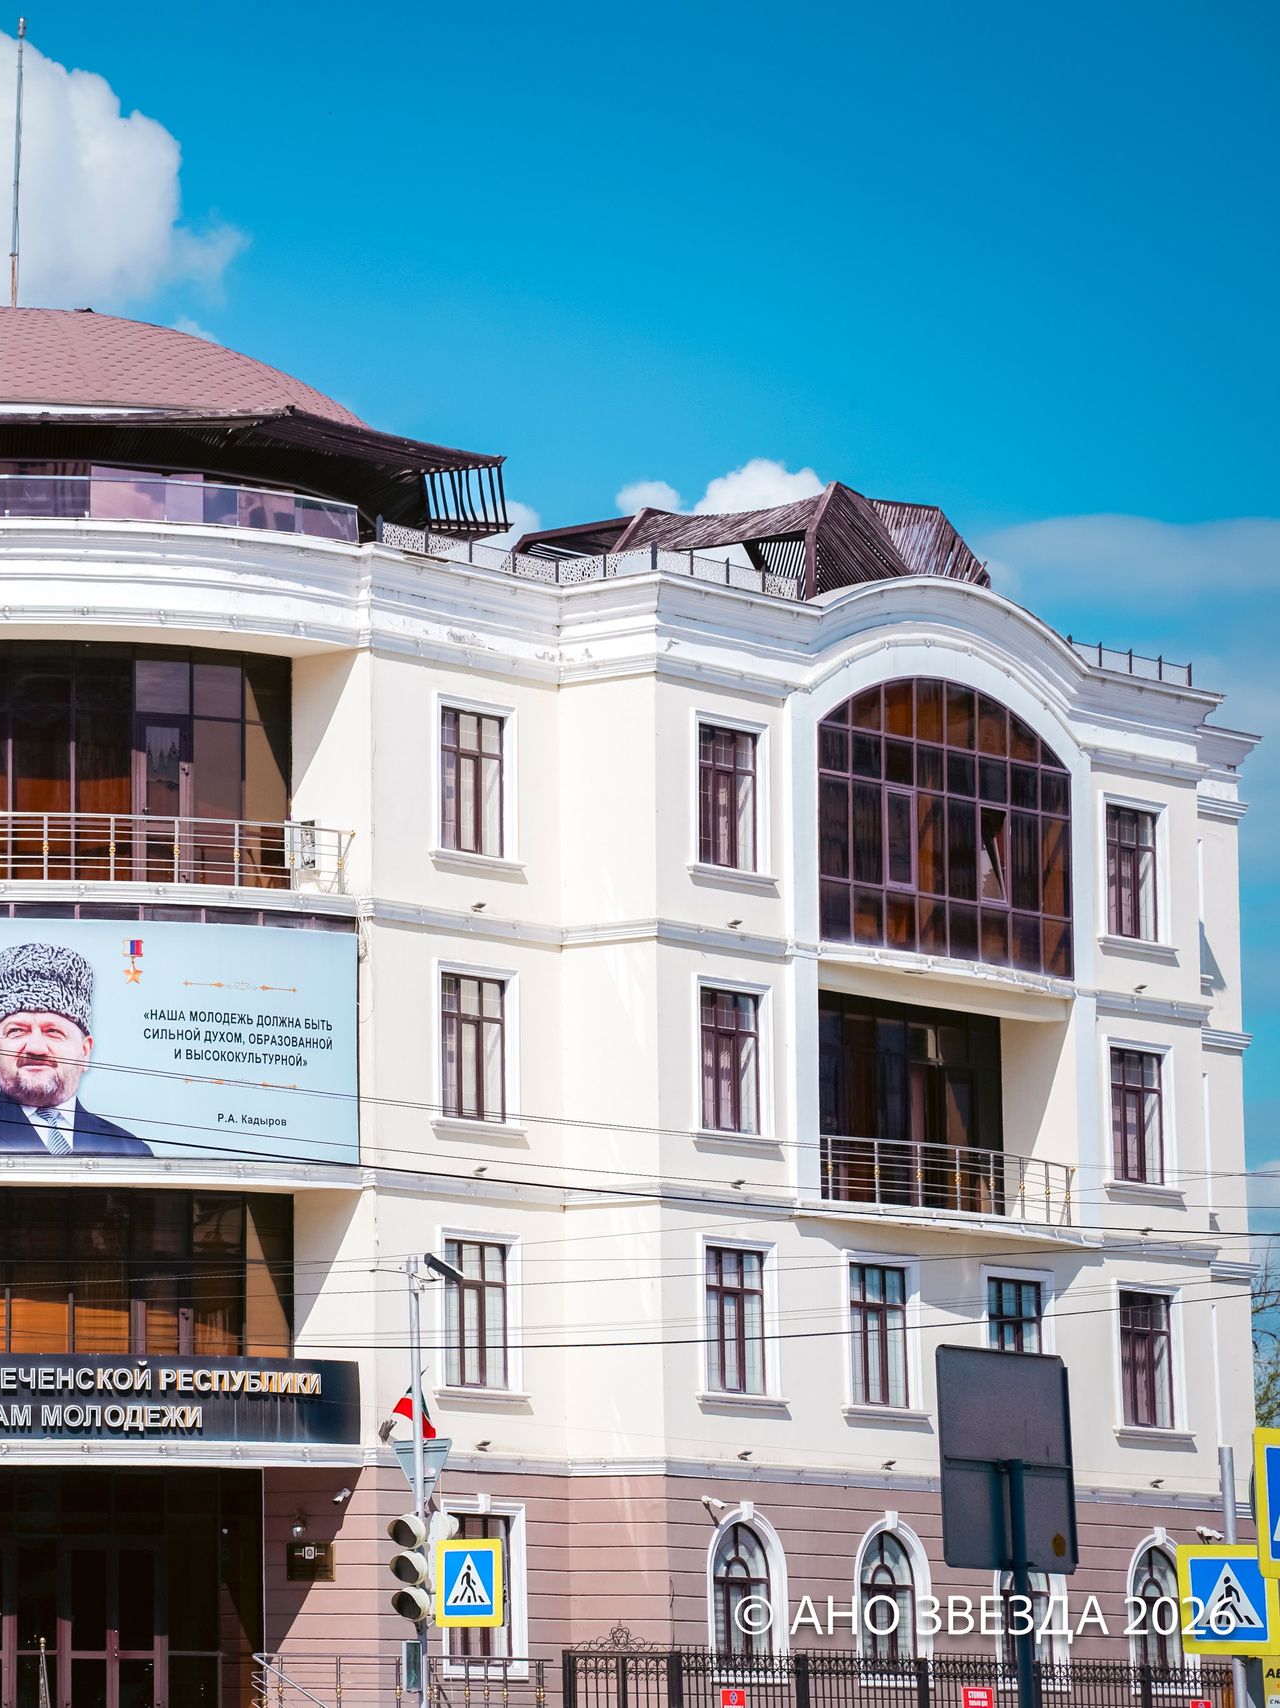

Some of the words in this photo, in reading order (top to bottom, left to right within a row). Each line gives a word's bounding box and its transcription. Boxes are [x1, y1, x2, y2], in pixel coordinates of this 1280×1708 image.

[143, 1008, 186, 1022] «НАША
[189, 1010, 254, 1026] МОЛОДЕЖЬ
[256, 1014, 302, 1029] ДОЛЖНА
[304, 1018, 333, 1031] БЫТЬ
[143, 1027, 201, 1041] СИЛЬНОЙ
[203, 1030, 246, 1045] ДУХОМ,
[248, 1033, 333, 1050] ОБРАЗОВАННОЙ
[174, 1048, 182, 1060] И
[185, 1049, 308, 1067] ВЫСОКОКУЛЬТУРНОЙ»
[217, 1113, 238, 1124] Р.А.
[241, 1114, 287, 1127] Кадыров
[159, 1369, 322, 1395] РЕСПУБЛИКИ
[41, 1405, 203, 1432] МОЛОДЕЖИ
